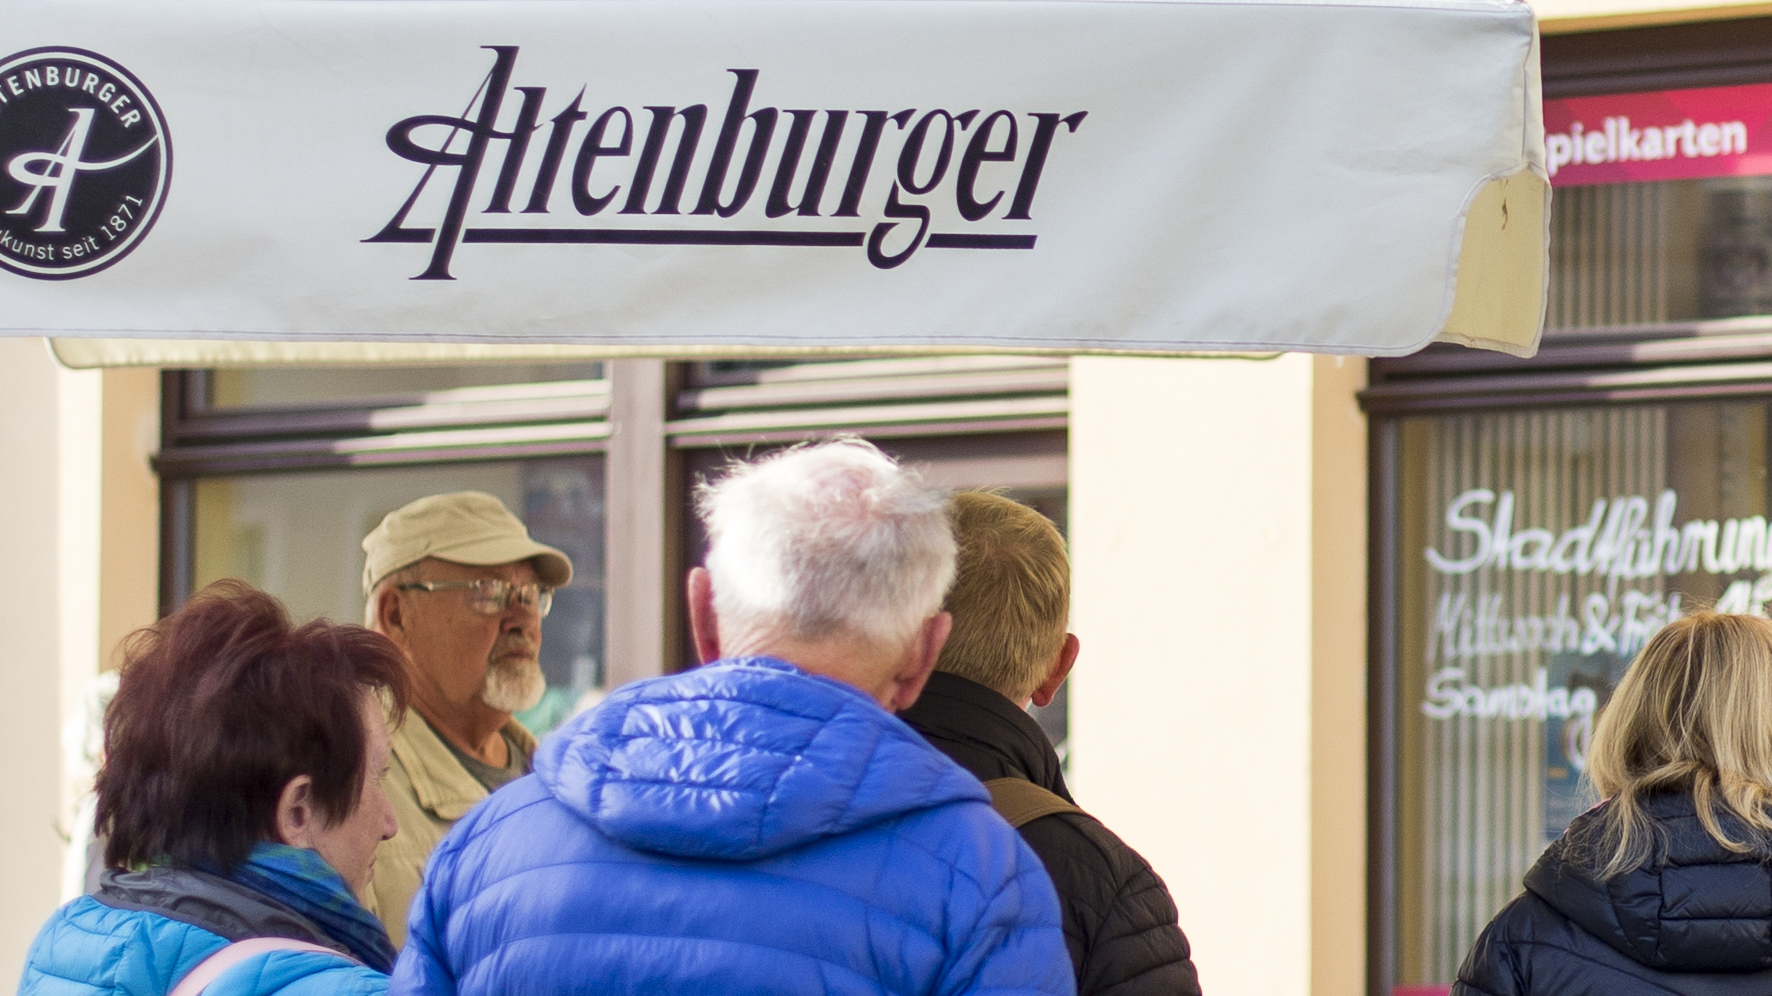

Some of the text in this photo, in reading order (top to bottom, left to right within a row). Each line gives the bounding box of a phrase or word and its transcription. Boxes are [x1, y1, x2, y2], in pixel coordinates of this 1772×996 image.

[360, 45, 1088, 280] Altenburger
[1546, 115, 1748, 177] pielkarten
[0, 195, 143, 260] kunst seit 1871
[1422, 665, 1600, 771] Samstag
